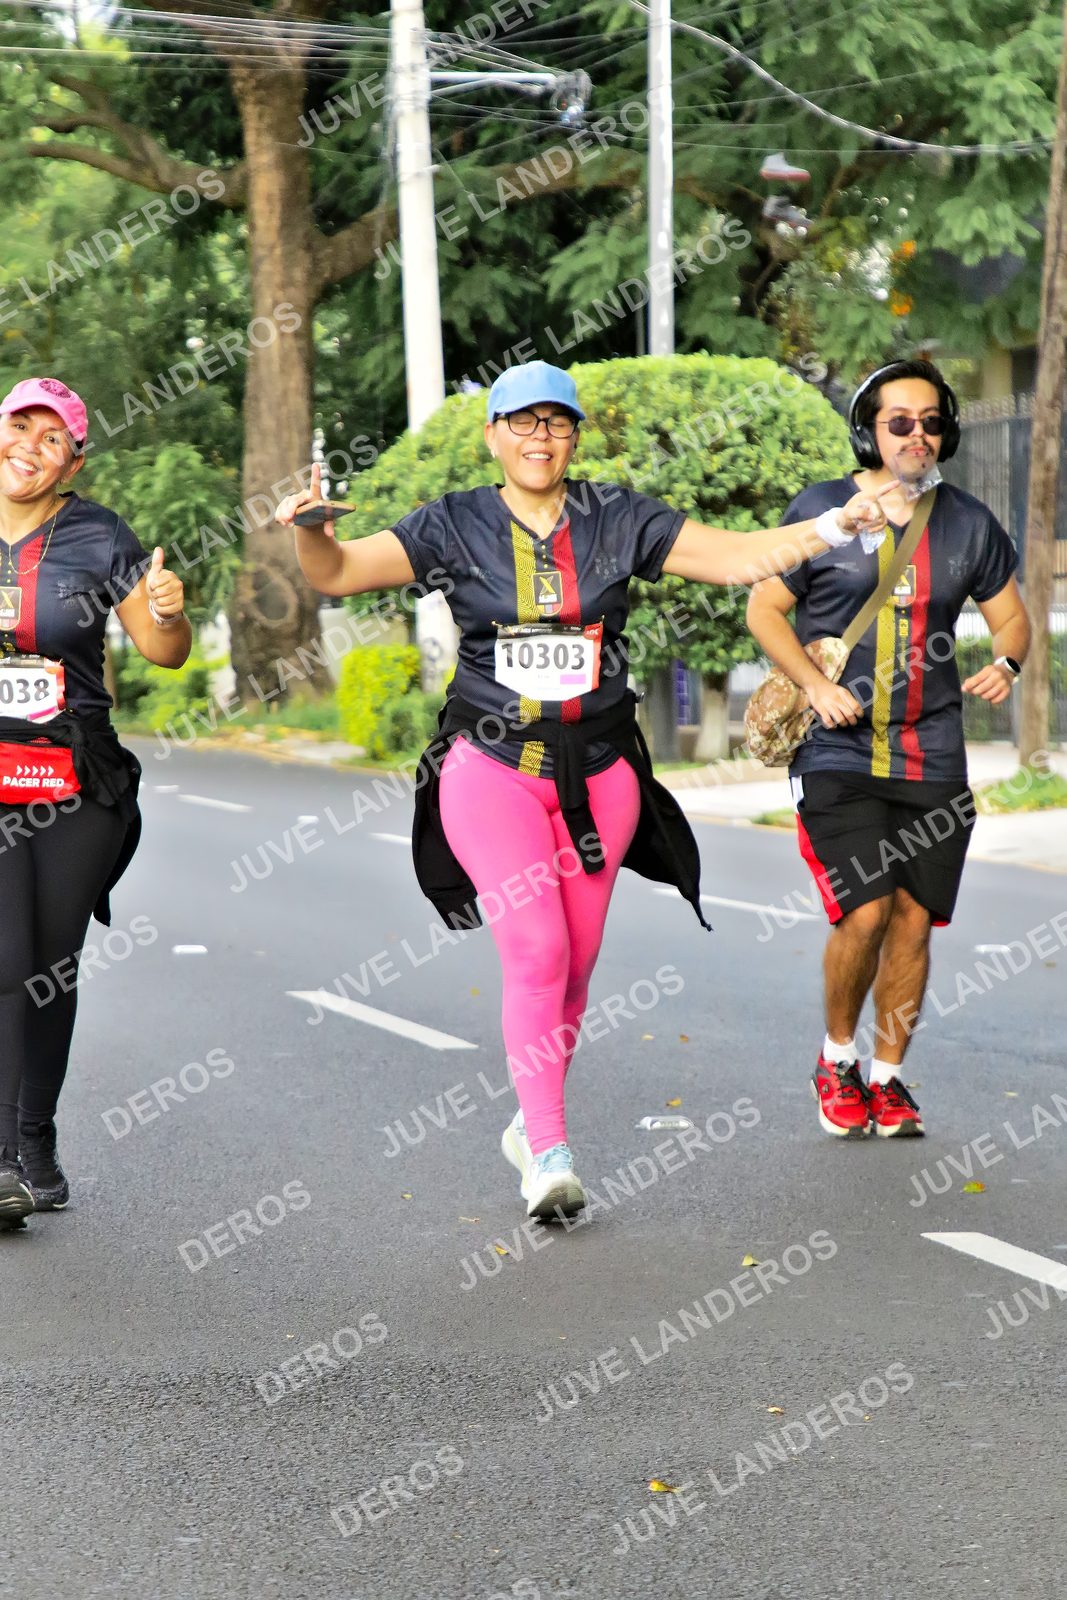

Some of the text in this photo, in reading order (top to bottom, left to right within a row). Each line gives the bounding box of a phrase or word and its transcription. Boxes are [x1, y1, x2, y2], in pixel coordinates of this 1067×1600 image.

[501, 643, 585, 670] 10303
[2, 776, 65, 788] PACER RED
